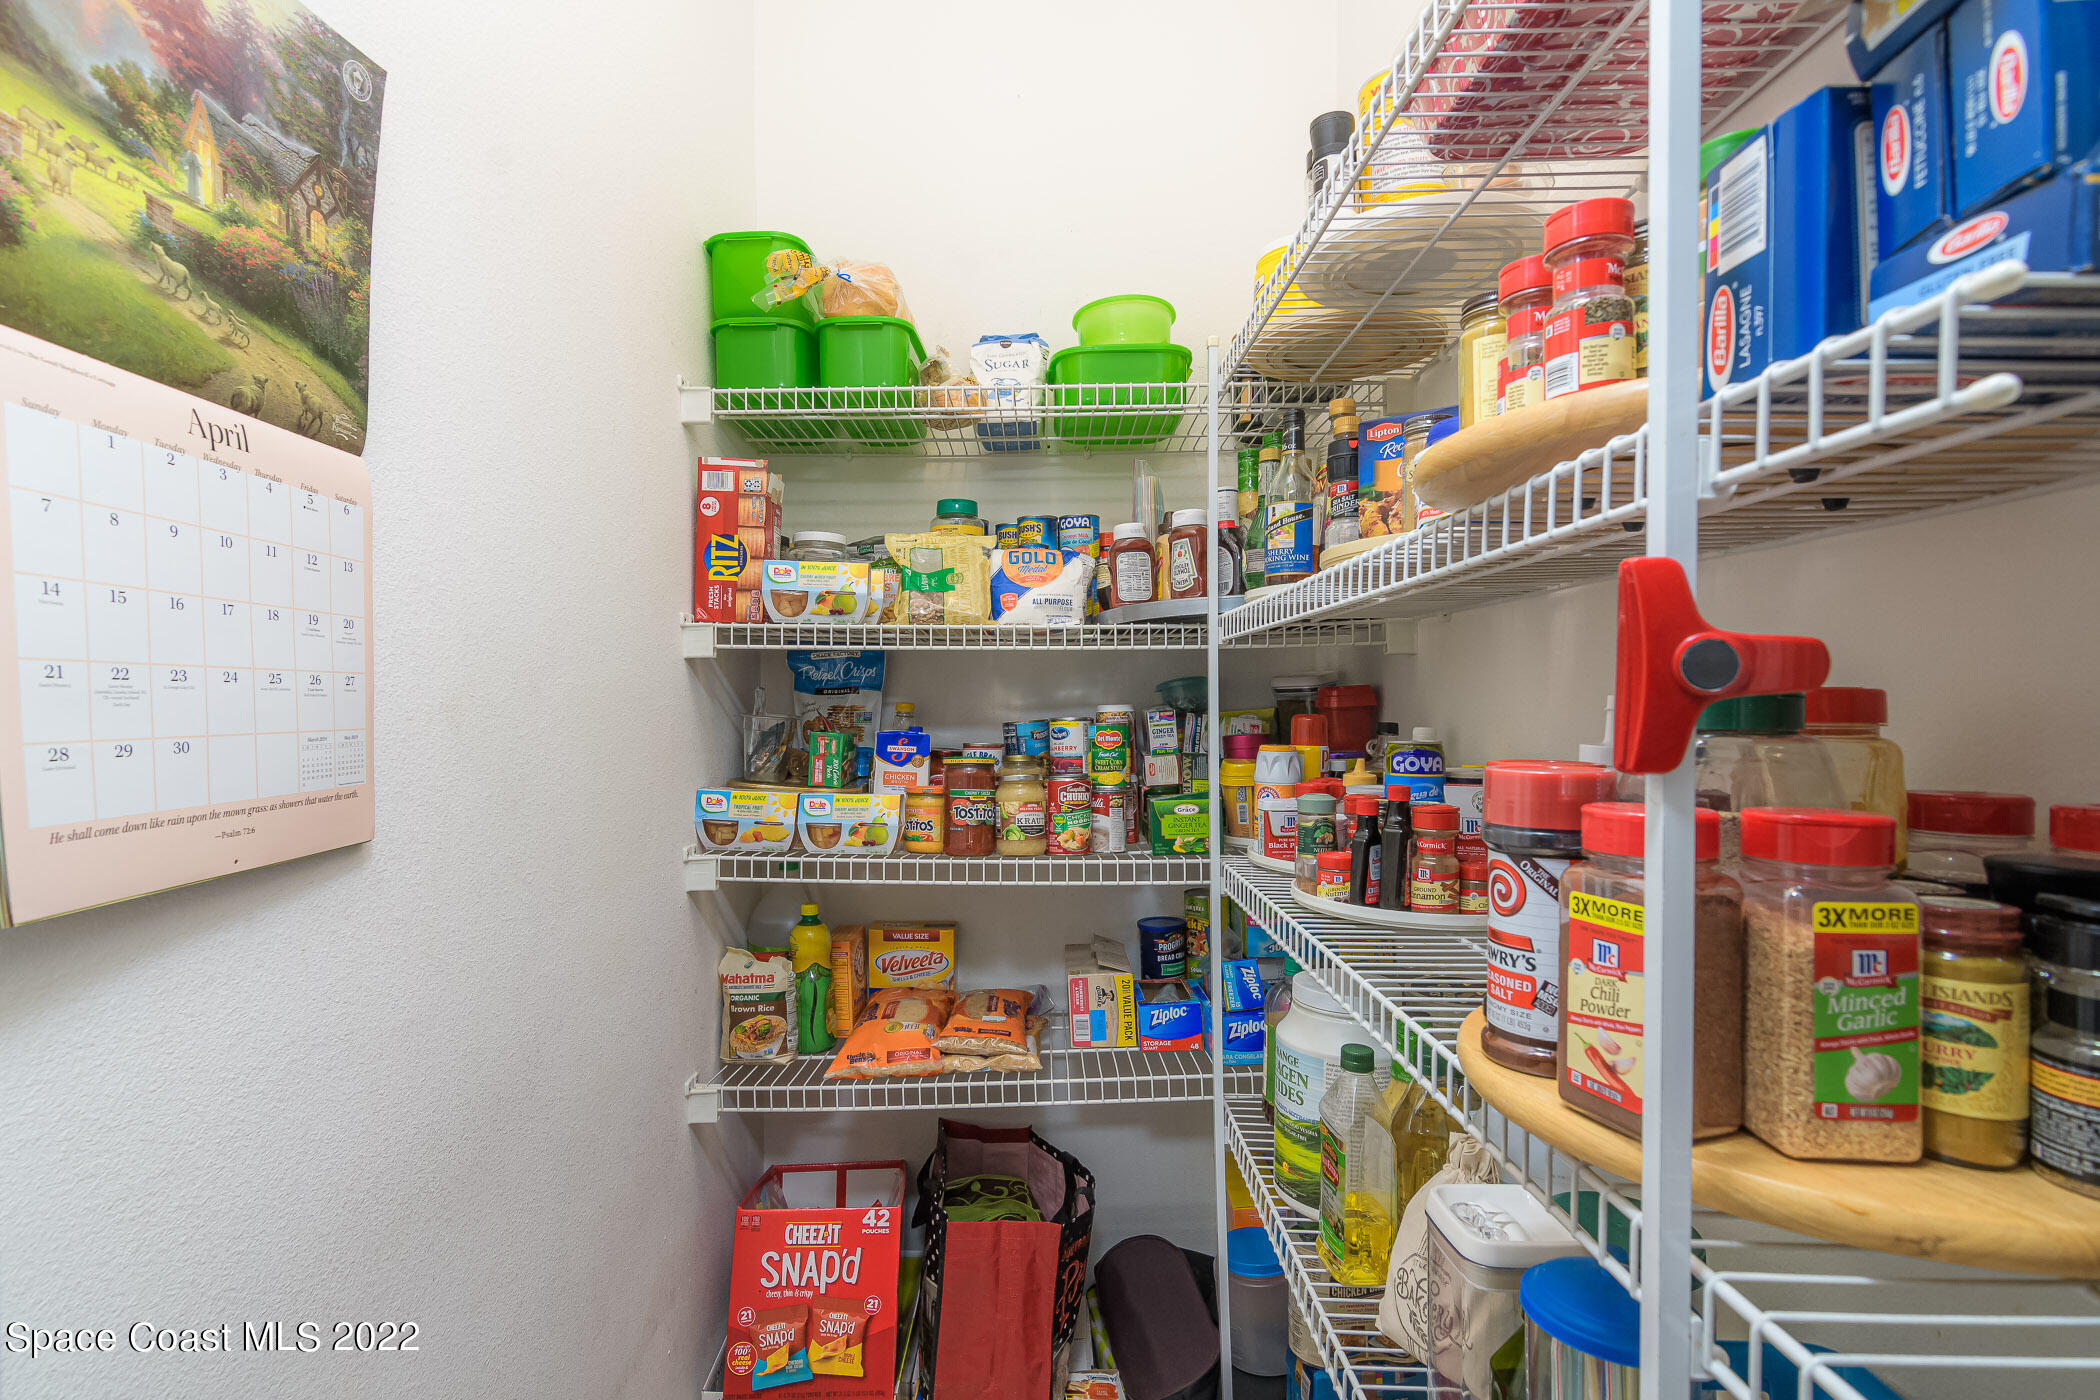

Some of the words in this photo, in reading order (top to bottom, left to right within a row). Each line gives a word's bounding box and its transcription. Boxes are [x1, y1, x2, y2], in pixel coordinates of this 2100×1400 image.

[1884, 113, 1902, 175] Barilla
[1714, 295, 1728, 366] Barilla
[1738, 283, 1753, 369] LASAGNE
[984, 358, 1031, 372] SUGAR
[187, 408, 250, 453] April
[1369, 426, 1400, 440] Lipton
[20, 397, 61, 418] Sunday
[92, 418, 129, 439] Monday
[154, 438, 187, 456] Tuesday
[203, 452, 242, 473] Wednesday
[254, 468, 282, 485] Thursday
[300, 482, 319, 495] Friday
[108, 435, 115, 449] 1
[166, 452, 175, 466] 2
[219, 468, 227, 480] 3
[265, 482, 272, 493] 4
[307, 494, 314, 505] 5
[343, 504, 350, 516] 6
[1341, 494, 1355, 502] SALT
[1060, 517, 1090, 529] GOYA
[41, 498, 52, 512] 7
[109, 512, 119, 527] 8
[169, 525, 178, 538] 9
[219, 535, 233, 549] 10
[265, 545, 277, 558] 11
[306, 553, 318, 566] 12
[343, 561, 353, 573] 13
[708, 534, 741, 581] RITZ
[1008, 550, 1057, 565] GOLD
[1267, 548, 1294, 556] SHERRY
[1291, 553, 1310, 561] WINE
[773, 567, 792, 575] Dole
[1017, 564, 1048, 575] Medal
[41, 580, 61, 597] 14
[109, 588, 128, 605] 15
[169, 596, 185, 611] 16
[221, 603, 235, 616] 17
[267, 608, 280, 621] 18
[307, 614, 319, 626] 19
[343, 618, 354, 630] 20
[1044, 598, 1073, 606] PURPOSE
[43, 664, 65, 679] 21
[110, 666, 130, 681] 22
[169, 669, 188, 682] 23
[222, 671, 239, 683] 24
[268, 672, 282, 685] 25
[309, 674, 322, 686] 26
[344, 675, 355, 686] 27
[798, 663, 841, 687] Pretzel
[840, 661, 877, 685] Crisps
[1152, 727, 1175, 735] GINGER
[47, 747, 70, 763] 28
[113, 743, 133, 758] 29
[172, 741, 190, 754] 30
[1392, 756, 1443, 773] GOYA
[706, 796, 724, 805] Dole
[808, 801, 827, 809] Dole
[49, 832, 64, 845] He
[67, 827, 92, 842] shall
[94, 825, 121, 838] come
[122, 821, 148, 834] down
[149, 817, 166, 829] like
[166, 815, 185, 827] rain
[186, 814, 208, 826] upon
[208, 809, 222, 821] the
[222, 807, 247, 818] mown
[269, 803, 278, 811] as
[279, 799, 304, 810] showers
[304, 796, 318, 806] that
[317, 794, 334, 804] water
[333, 792, 344, 802] the
[1520, 860, 1559, 898] ORIGINAL
[1537, 867, 1550, 880] THE
[1572, 896, 1590, 917] 3X
[1591, 900, 1644, 923] MORE
[1818, 907, 1847, 928] 3X
[1849, 907, 1915, 921] MORE
[892, 932, 913, 940] VALUE
[914, 932, 929, 940] SIZE
[881, 951, 944, 975] Velveeta
[1157, 954, 1175, 962] BREAD
[892, 973, 909, 983] SHELLS
[914, 970, 932, 980] CHEESE
[1588, 963, 1622, 977] McCormick
[720, 973, 775, 985] Mahatma
[1121, 979, 1131, 989] 20
[1240, 965, 1262, 1000] Ziploc
[1594, 978, 1617, 988] DARK
[1846, 974, 1893, 986] McCormick
[1226, 980, 1236, 1008] FREEZER
[1490, 984, 1513, 1002] SALT
[1590, 985, 1620, 1003] Chili
[1827, 985, 1907, 1015] Minced
[1930, 982, 2014, 1007] ISLANDS
[730, 1004, 756, 1013] Brown
[757, 1004, 775, 1012] Rice
[1122, 994, 1132, 1019] VALUE
[1512, 1008, 1533, 1020] SIZE
[1580, 998, 1632, 1020] Powder
[1150, 1005, 1188, 1026] Ziploc
[1836, 1009, 1899, 1033] Garlic
[1123, 1021, 1133, 1041] PACK
[1190, 1042, 1200, 1050] 48
[861, 1209, 890, 1227] 42
[783, 1288, 793, 1297] thin
[794, 1288, 799, 1297] &
[799, 1288, 814, 1298] crispy
[1331, 1286, 1360, 1297] CHICKEN
[867, 1299, 878, 1308] 21
[740, 1310, 752, 1320] 21
